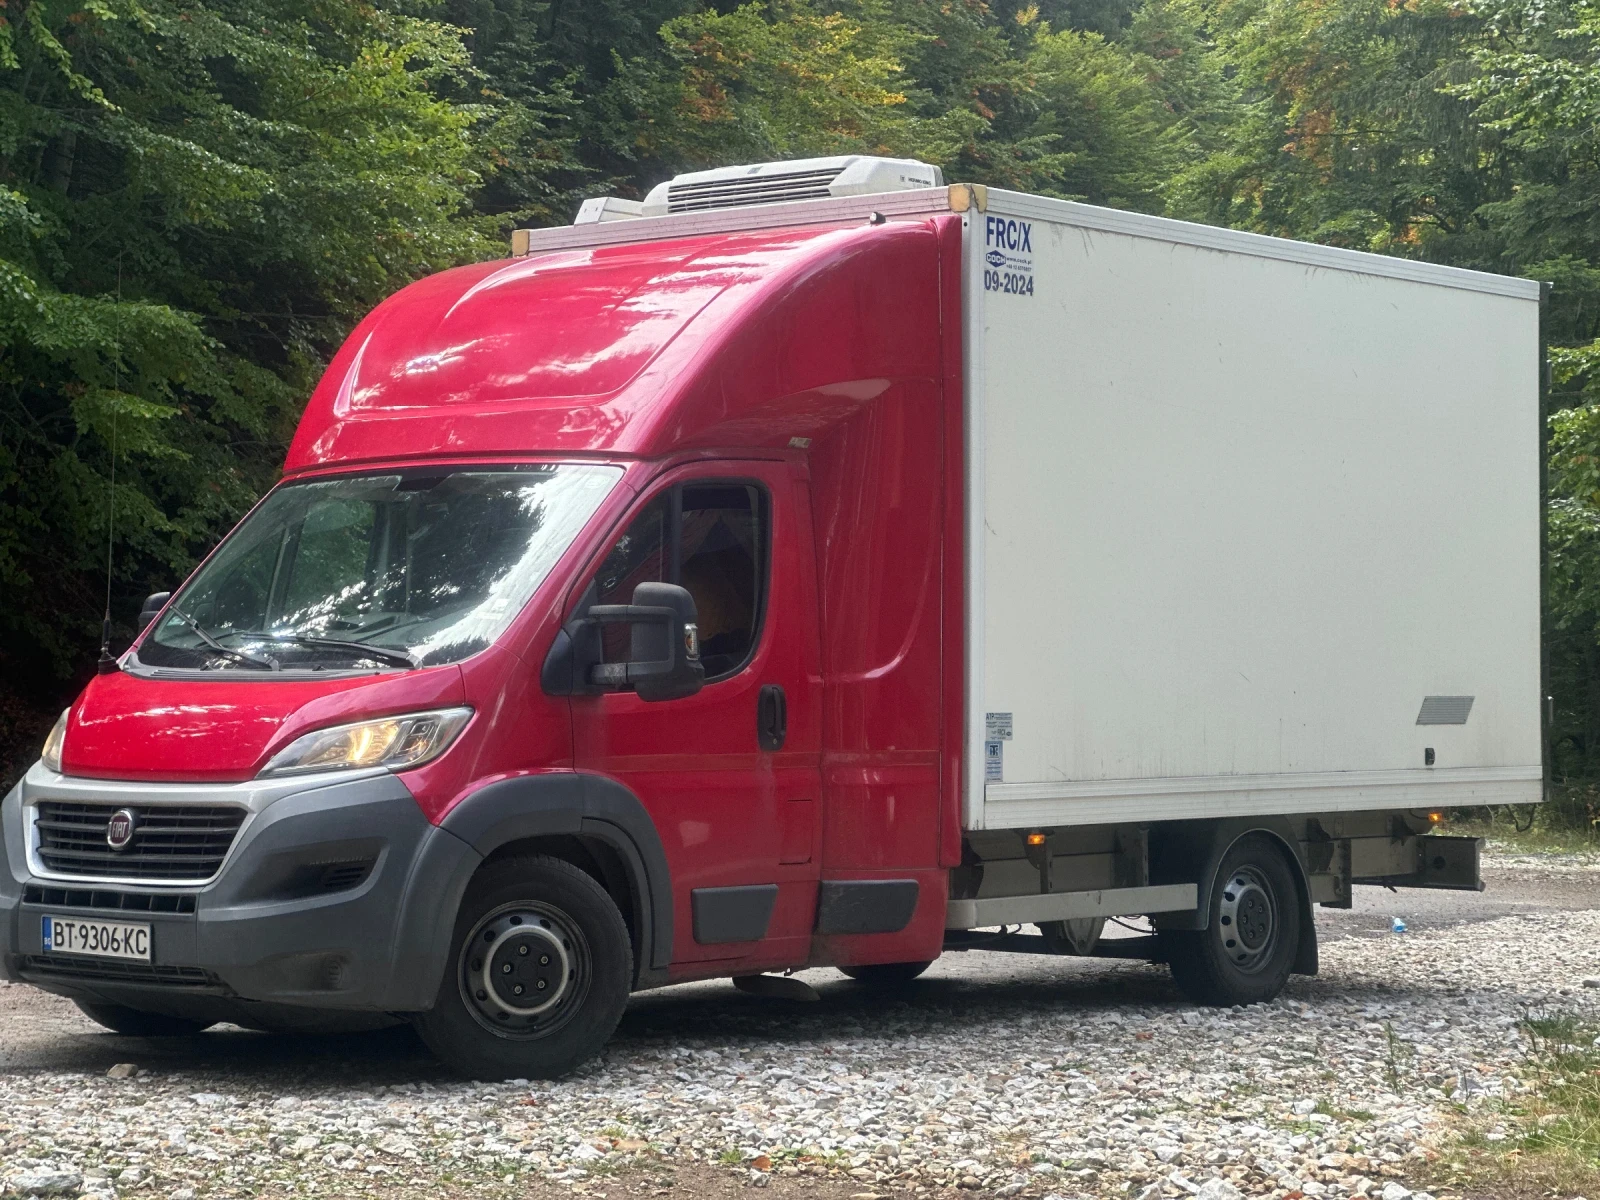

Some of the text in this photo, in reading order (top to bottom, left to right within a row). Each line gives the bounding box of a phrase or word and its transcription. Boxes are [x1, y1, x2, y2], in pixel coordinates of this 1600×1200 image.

[986, 216, 1031, 253] FRC/X
[984, 270, 1034, 296] 09-2024
[112, 822, 128, 838] FIAT
